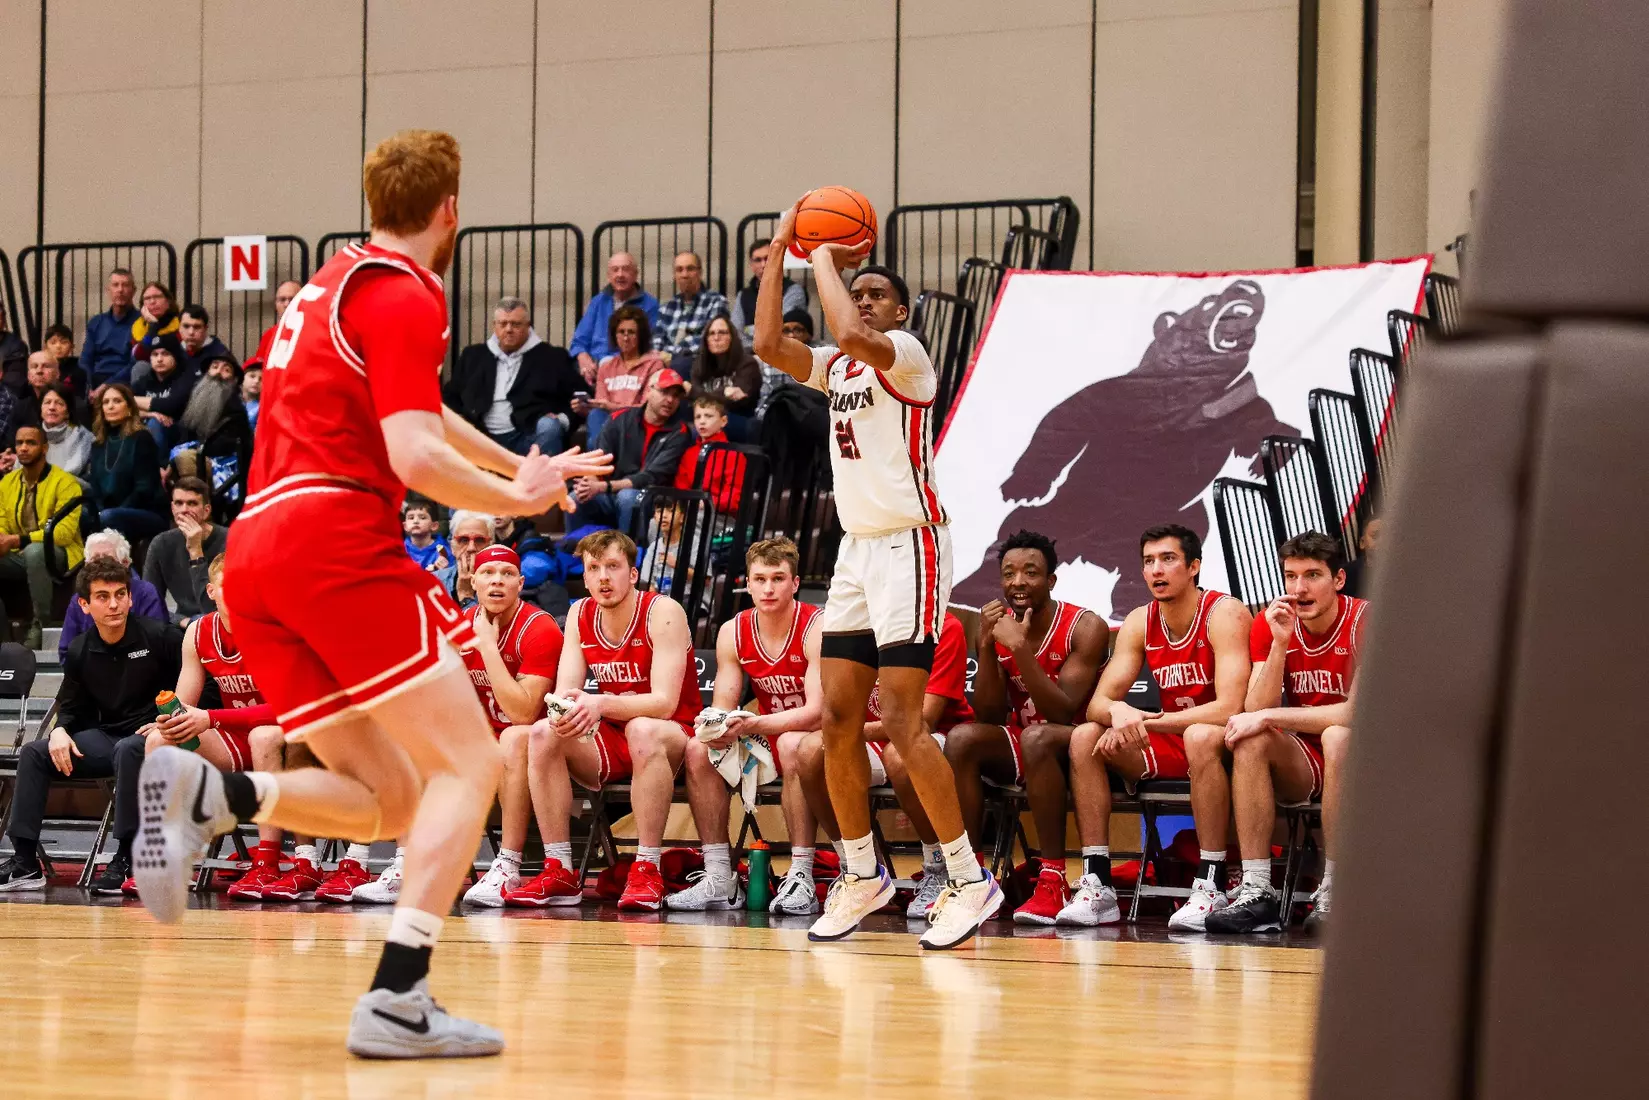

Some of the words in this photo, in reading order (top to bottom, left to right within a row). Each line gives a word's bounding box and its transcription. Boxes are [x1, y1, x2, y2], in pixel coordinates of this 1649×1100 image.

[231, 244, 260, 281] N
[427, 584, 459, 623] C
[213, 674, 260, 693] ORNEL
[1152, 662, 1214, 690] CORNELL
